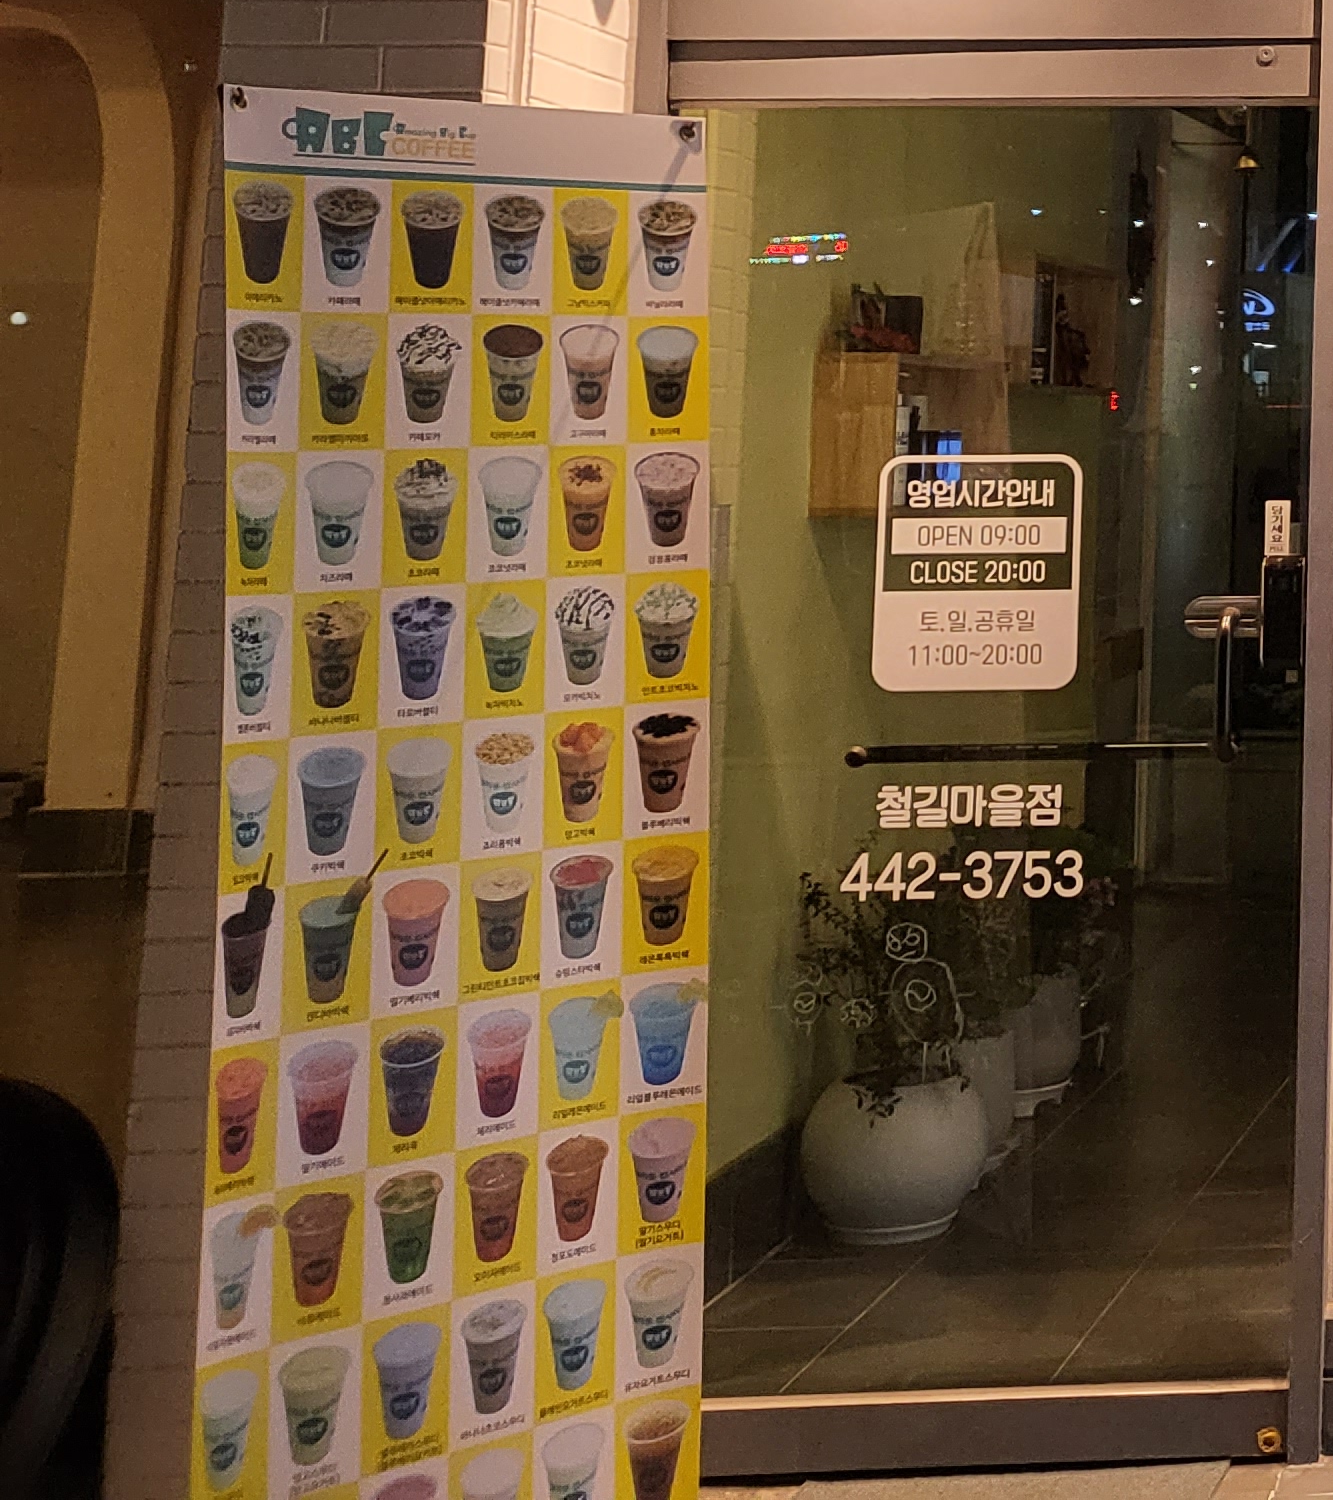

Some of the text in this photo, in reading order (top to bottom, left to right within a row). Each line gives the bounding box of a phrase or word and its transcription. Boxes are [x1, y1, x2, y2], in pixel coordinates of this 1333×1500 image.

[391, 137, 476, 160] COFFEE
[907, 478, 1056, 510] 영업시간안내
[917, 524, 1041, 547] OPEN 09:00
[910, 559, 1047, 585] CLOSE 20:00
[907, 643, 1043, 668] 11:00~20:00
[876, 782, 1064, 830] 철길마을점
[839, 849, 1085, 902] 442-3753
